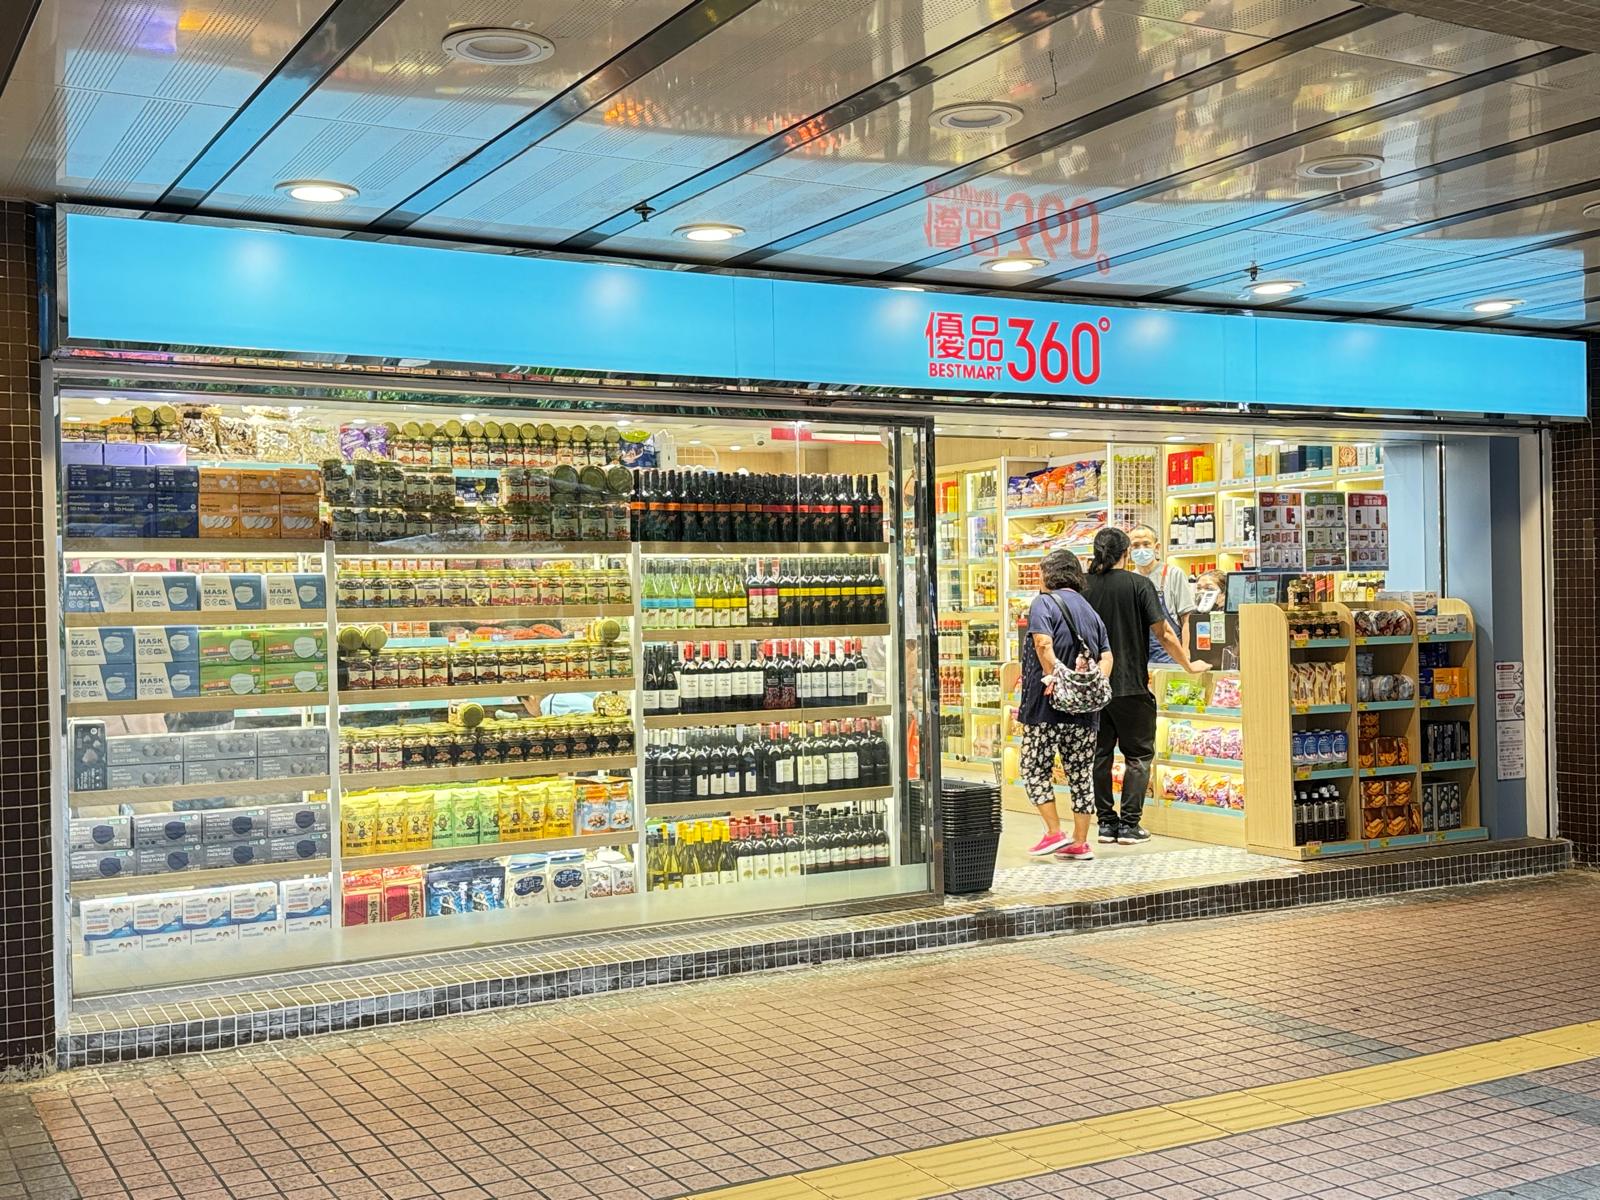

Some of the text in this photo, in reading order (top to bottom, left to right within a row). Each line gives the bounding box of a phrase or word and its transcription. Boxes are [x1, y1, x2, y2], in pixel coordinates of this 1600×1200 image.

[929, 362, 1003, 381] BESTMART
[68, 589, 95, 597] MASK
[139, 677, 165, 685] MASK
